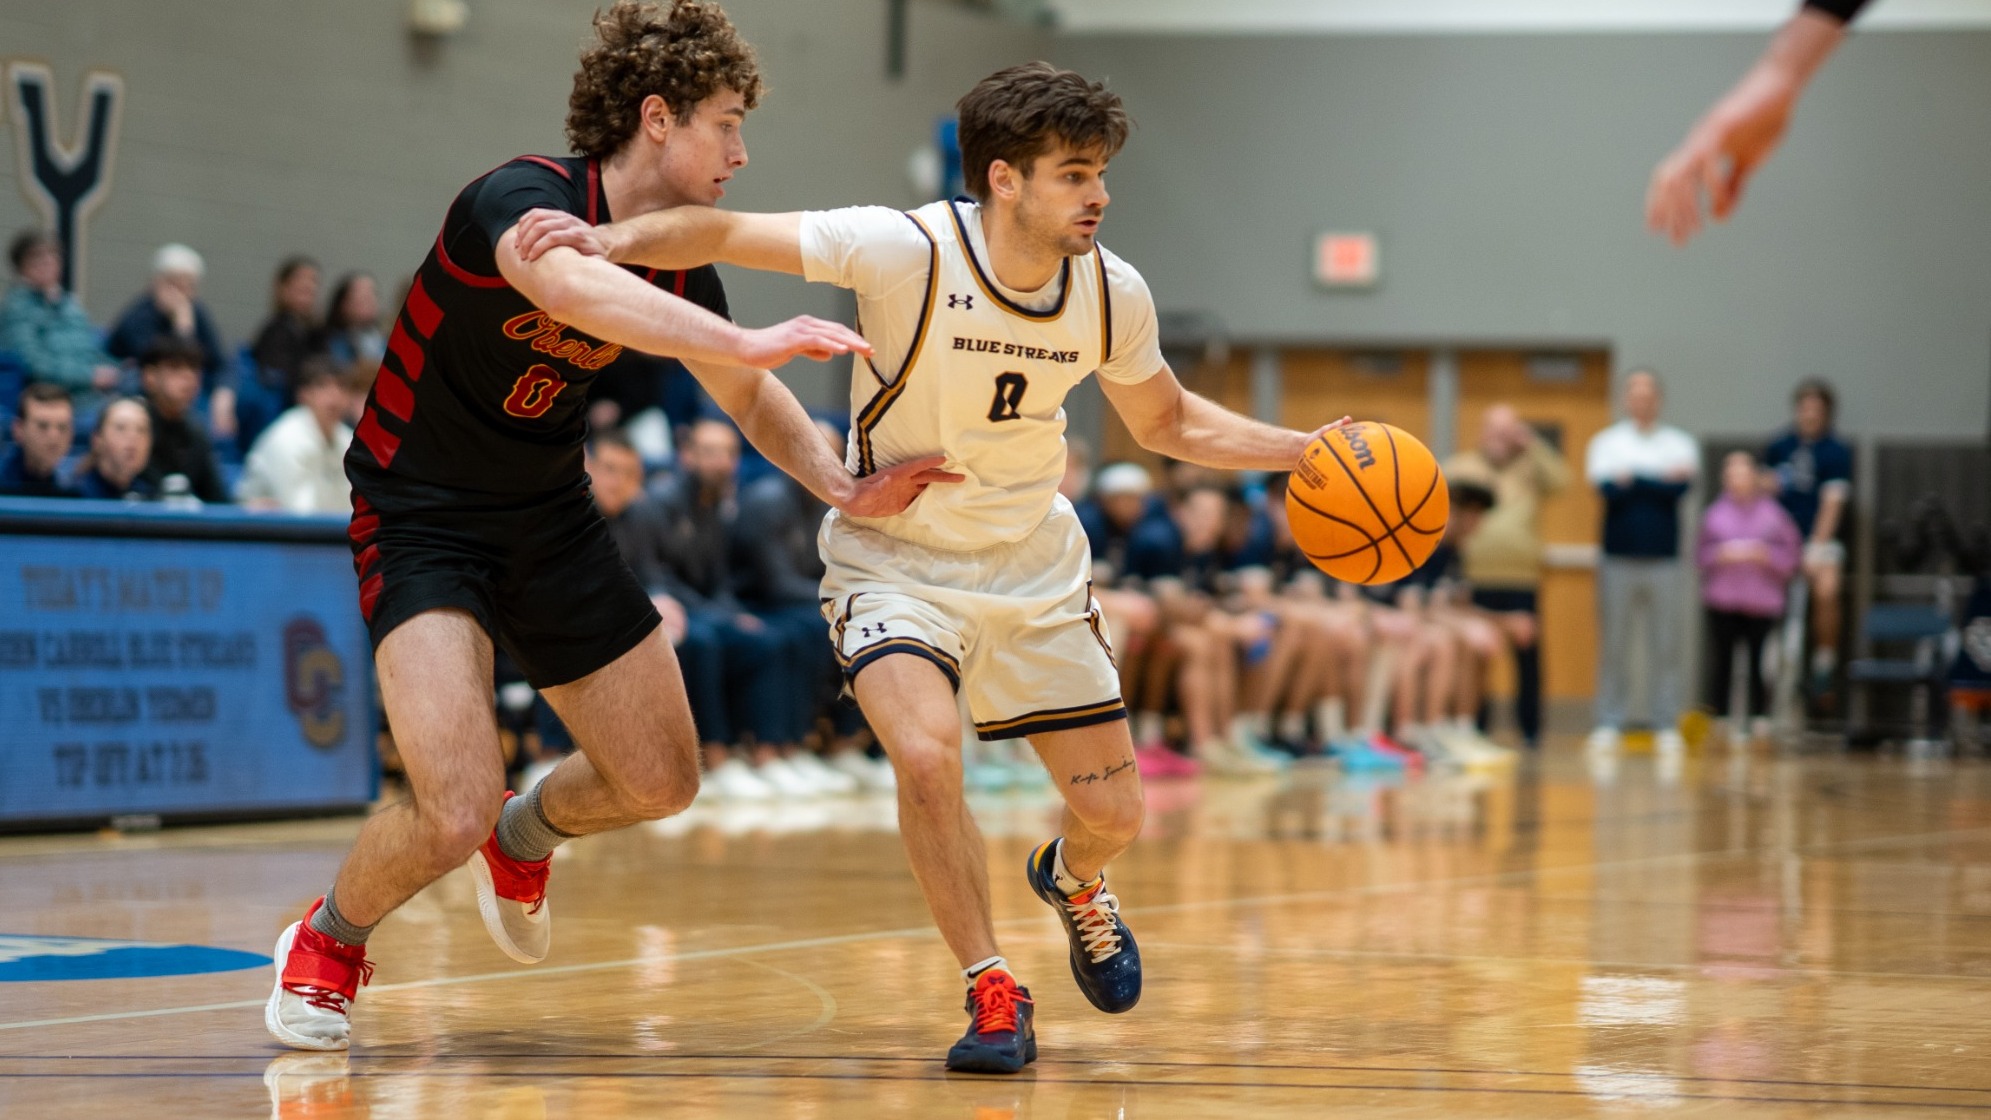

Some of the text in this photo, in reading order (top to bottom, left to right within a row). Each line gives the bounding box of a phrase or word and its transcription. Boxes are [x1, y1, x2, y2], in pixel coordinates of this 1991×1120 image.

[952, 337, 1079, 363] BLUE STREAKS
[503, 363, 567, 418] 0
[987, 371, 1028, 422] 0
